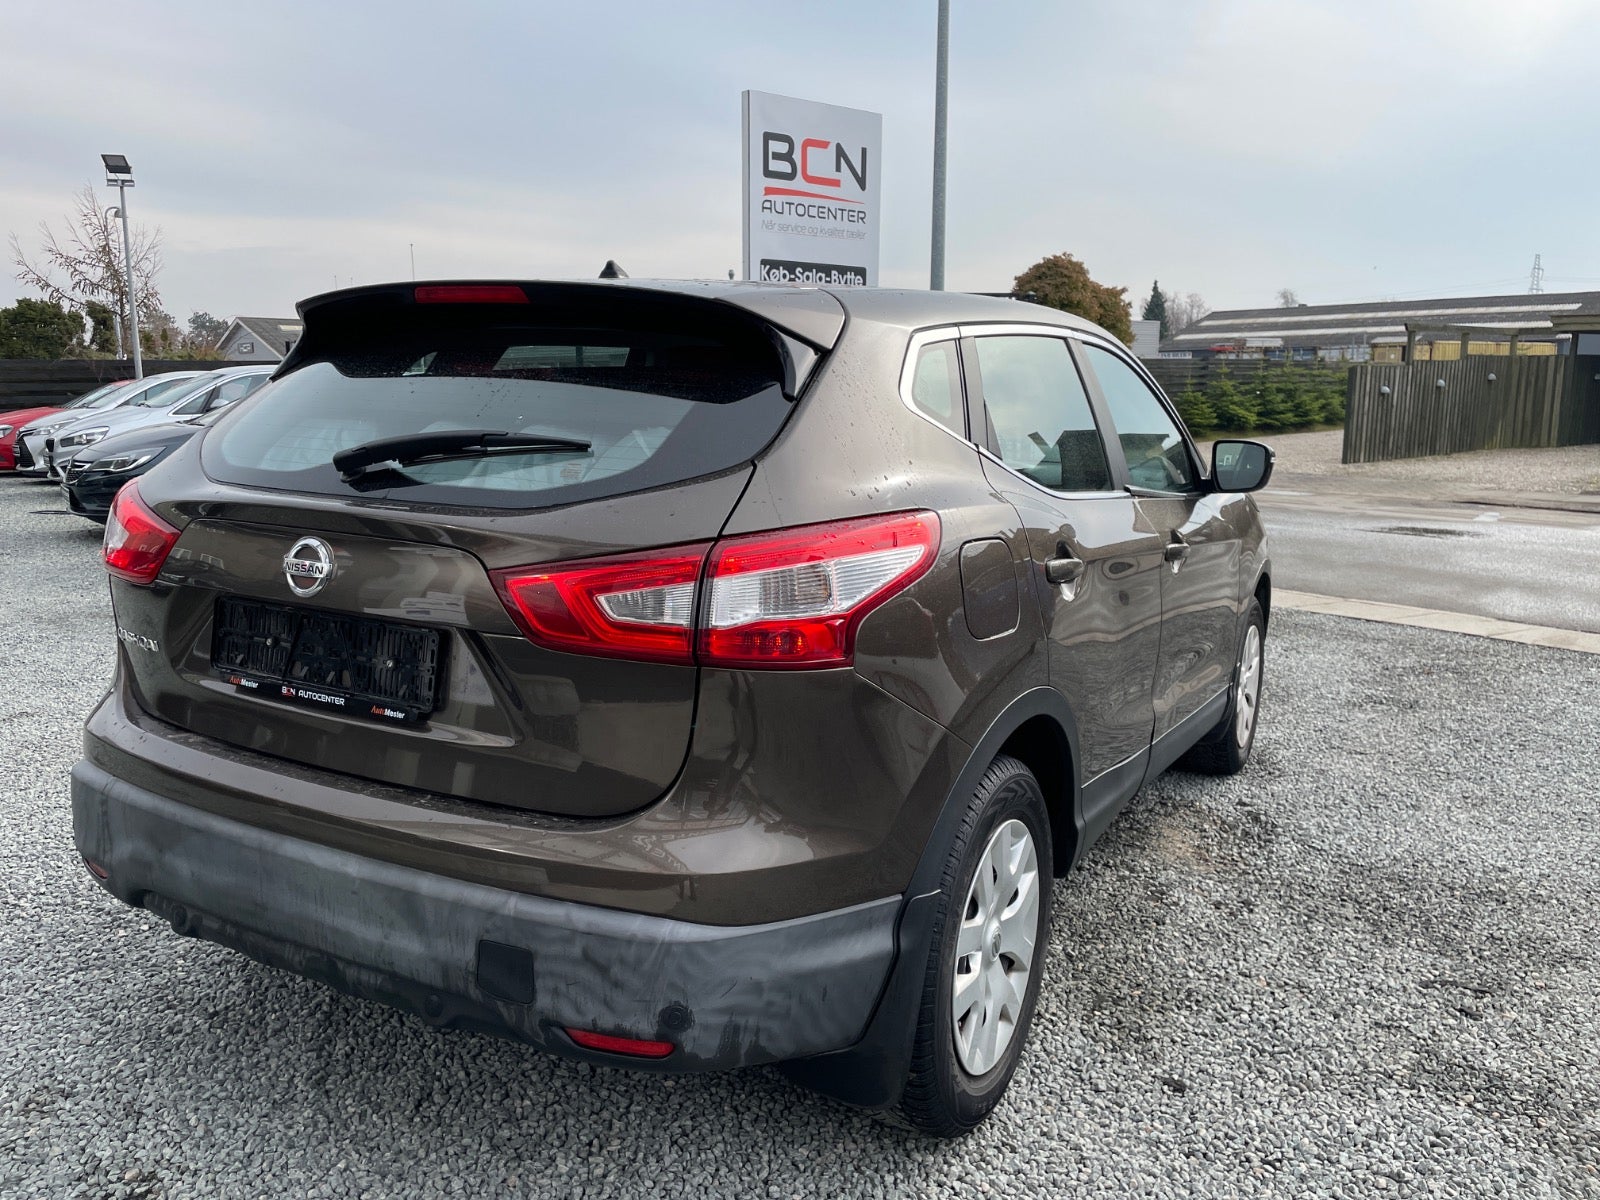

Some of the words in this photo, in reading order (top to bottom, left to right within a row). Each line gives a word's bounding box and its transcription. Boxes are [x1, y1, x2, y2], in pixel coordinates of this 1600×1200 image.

[763, 131, 867, 191] BCN
[761, 199, 867, 224] AUTOCENTER
[761, 219, 776, 231] Når
[777, 222, 807, 233] service
[807, 226, 818, 236] og
[286, 561, 324, 575] NISSAN
[281, 686, 296, 696] BCN
[298, 690, 345, 706] AUTOCENTER
